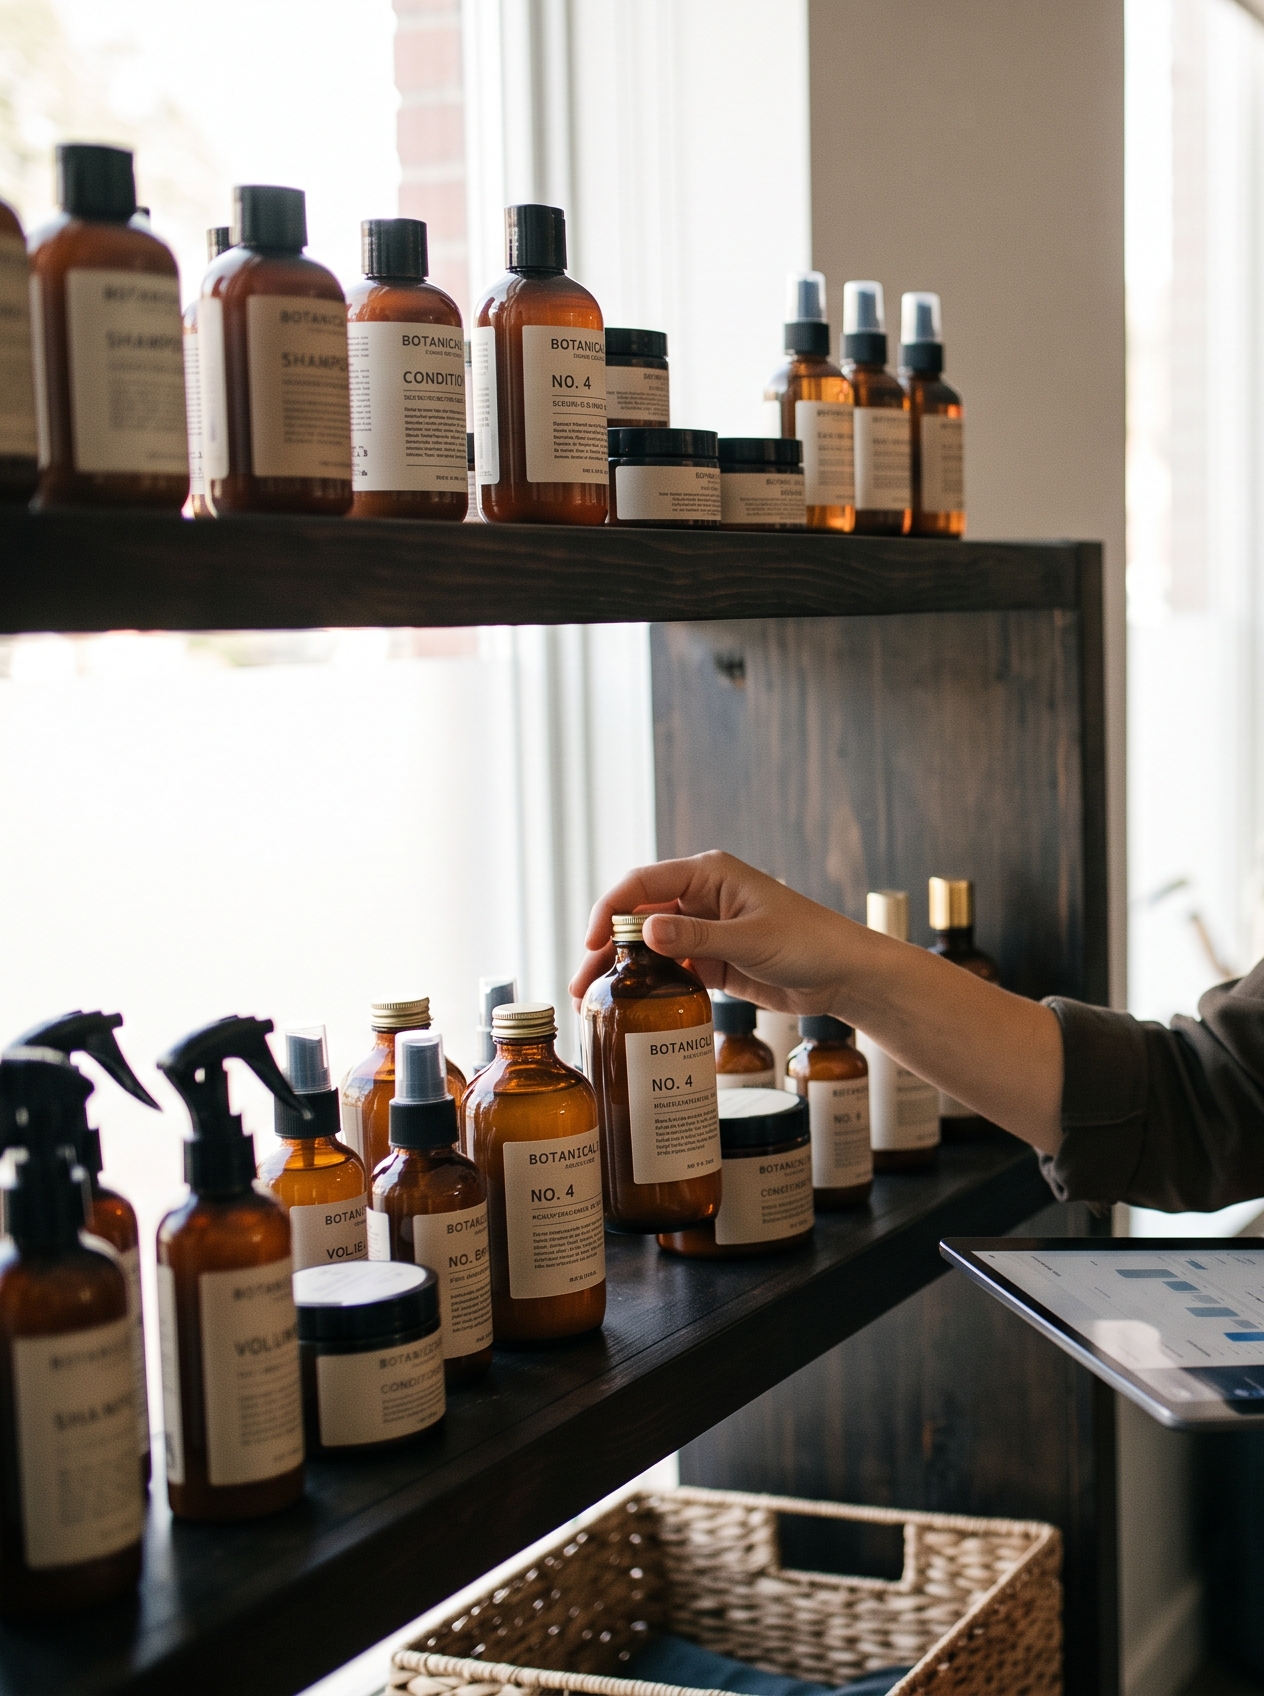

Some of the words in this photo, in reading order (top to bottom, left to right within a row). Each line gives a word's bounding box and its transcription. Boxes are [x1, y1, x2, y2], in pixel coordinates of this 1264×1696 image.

[403, 370, 465, 387] CONDITIO
[552, 374, 579, 389] NO.
[583, 376, 592, 390] 4
[652, 1077, 680, 1092] NO.
[685, 1074, 693, 1088] 4
[531, 1187, 561, 1203] NO.
[565, 1184, 575, 1198] 4
